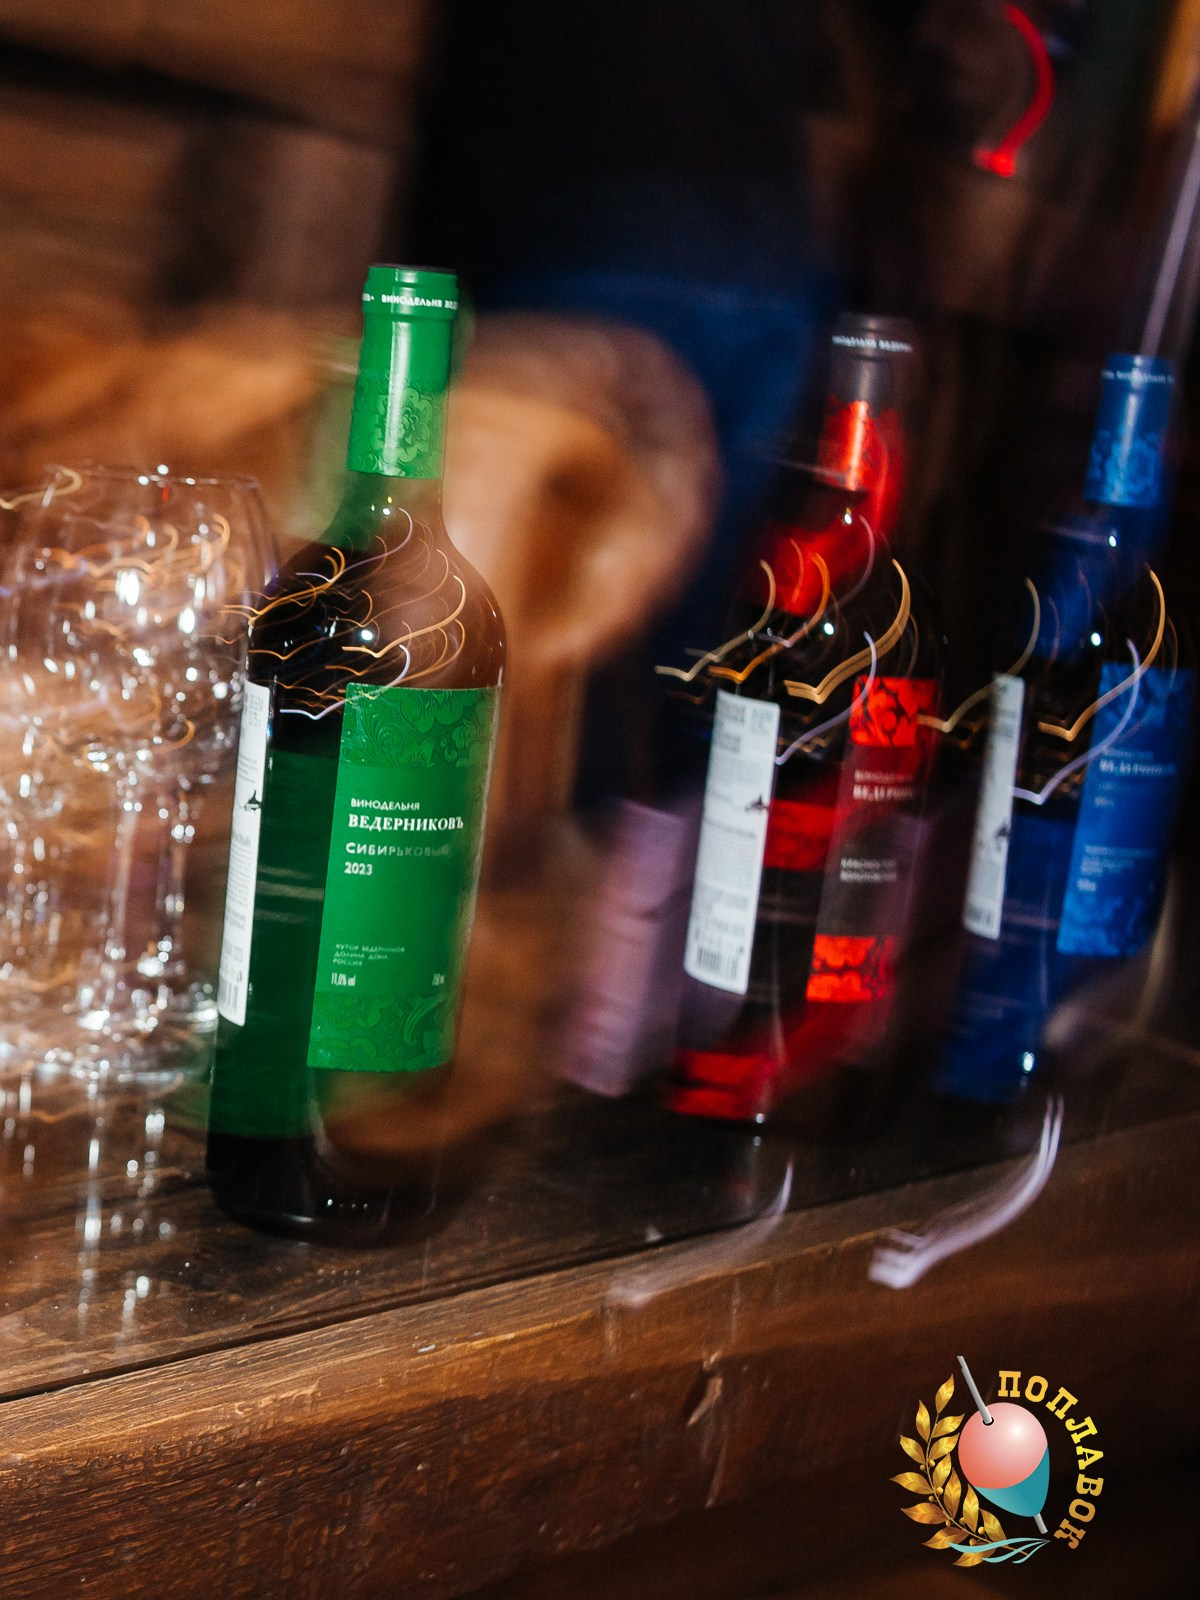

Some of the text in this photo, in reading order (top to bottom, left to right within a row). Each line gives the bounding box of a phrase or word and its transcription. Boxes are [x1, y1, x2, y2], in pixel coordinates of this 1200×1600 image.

[381, 294, 442, 308] ВИНОДЕЛЬНЯ
[350, 797, 420, 811] ВИНОДЕЛЬНЯ
[348, 813, 464, 832] ВЕДЕРНИКОВЪ
[344, 861, 373, 876] 2023
